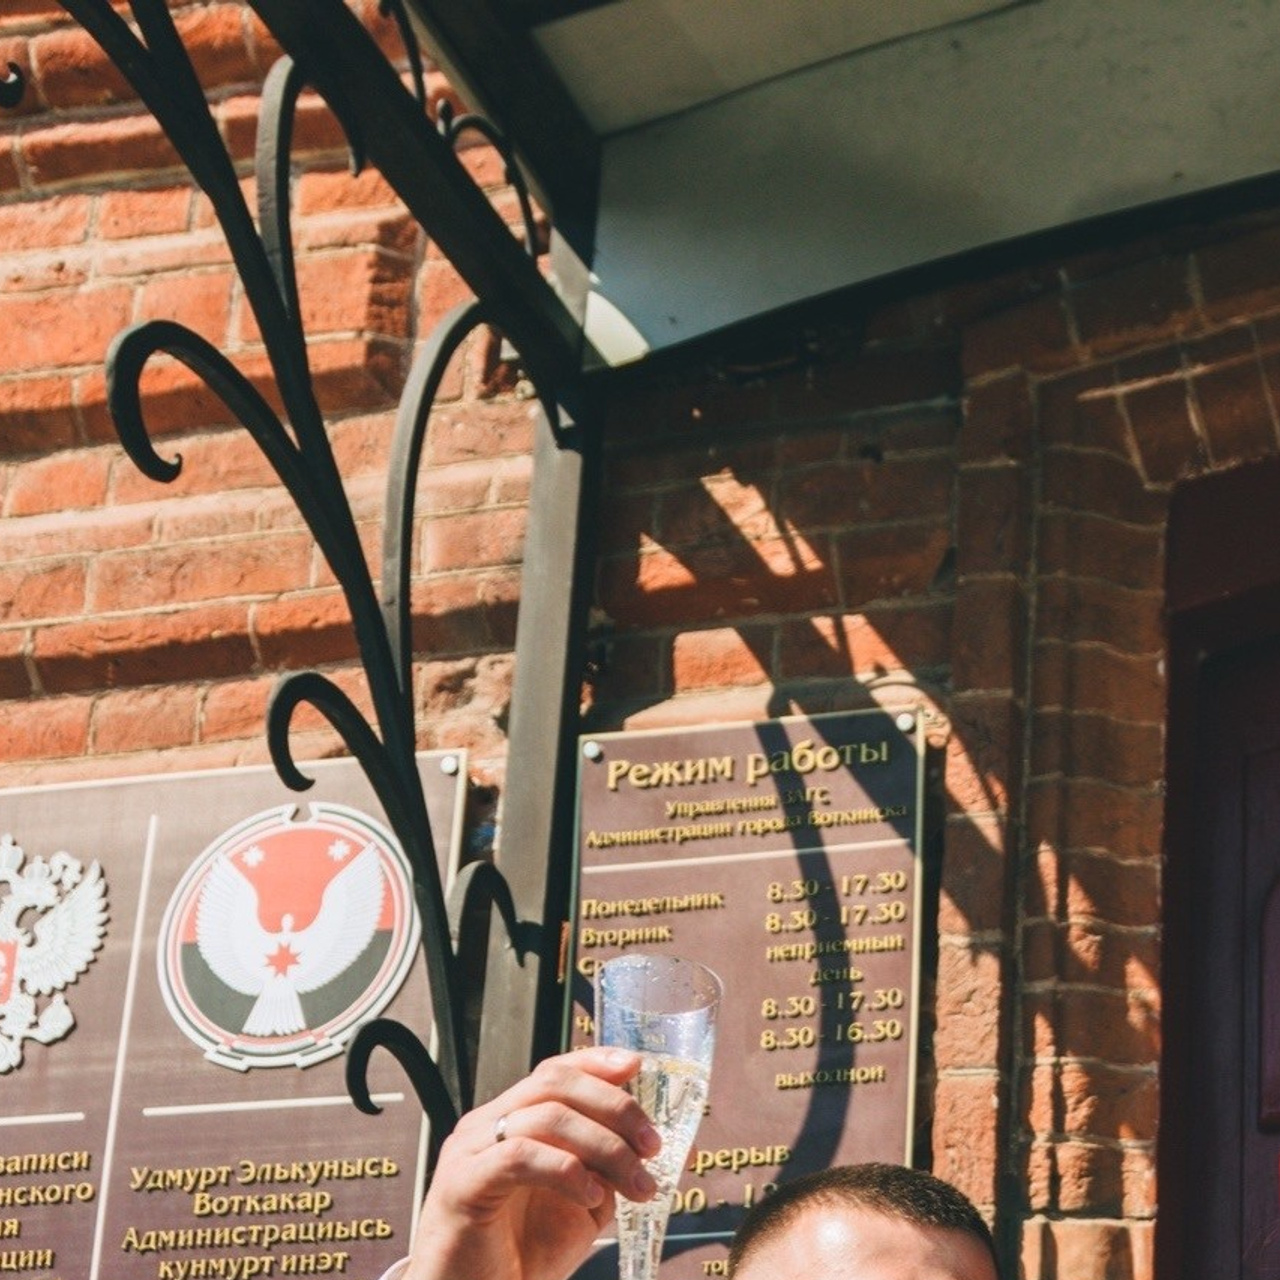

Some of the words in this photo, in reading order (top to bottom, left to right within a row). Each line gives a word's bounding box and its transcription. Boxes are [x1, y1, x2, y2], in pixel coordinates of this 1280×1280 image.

[607, 756, 733, 791] Режим
[746, 740, 889, 787] работы
[581, 892, 725, 919] Понедельник
[767, 879, 819, 903] 8.30
[841, 871, 907, 896] 17.30
[581, 926, 673, 948] Вторник
[765, 910, 817, 933] 8.30
[841, 901, 906, 925] 17.30
[761, 996, 817, 1019] 8.30
[837, 987, 904, 1012] 17.30
[760, 1026, 815, 1050] 8.30
[836, 1019, 902, 1042] 16.30
[129, 1166, 232, 1191] Удмурт
[236, 1157, 400, 1185] Элькунысь
[695, 1145, 790, 1175] рерыв
[193, 1191, 333, 1217] Воткакар
[121, 1219, 394, 1254] Администрациысь
[280, 1252, 350, 1273] инэт
